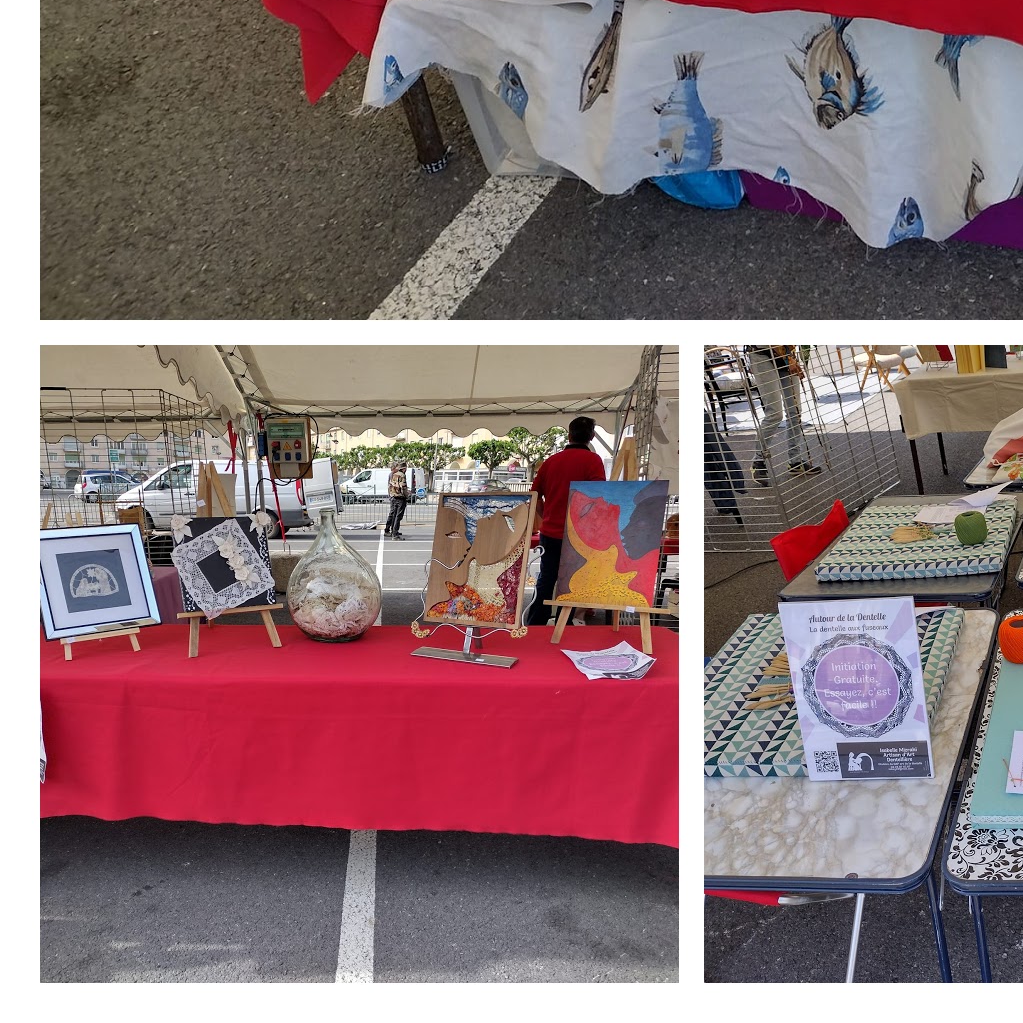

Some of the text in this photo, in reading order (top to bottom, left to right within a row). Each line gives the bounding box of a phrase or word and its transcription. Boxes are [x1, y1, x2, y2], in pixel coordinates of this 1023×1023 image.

[808, 612, 887, 624] Autour de la Dentelle
[831, 661, 877, 672] Initiation
[833, 675, 879, 684] Gratuite.
[824, 687, 892, 699] Essayez, c'est
[841, 700, 868, 711] facile
